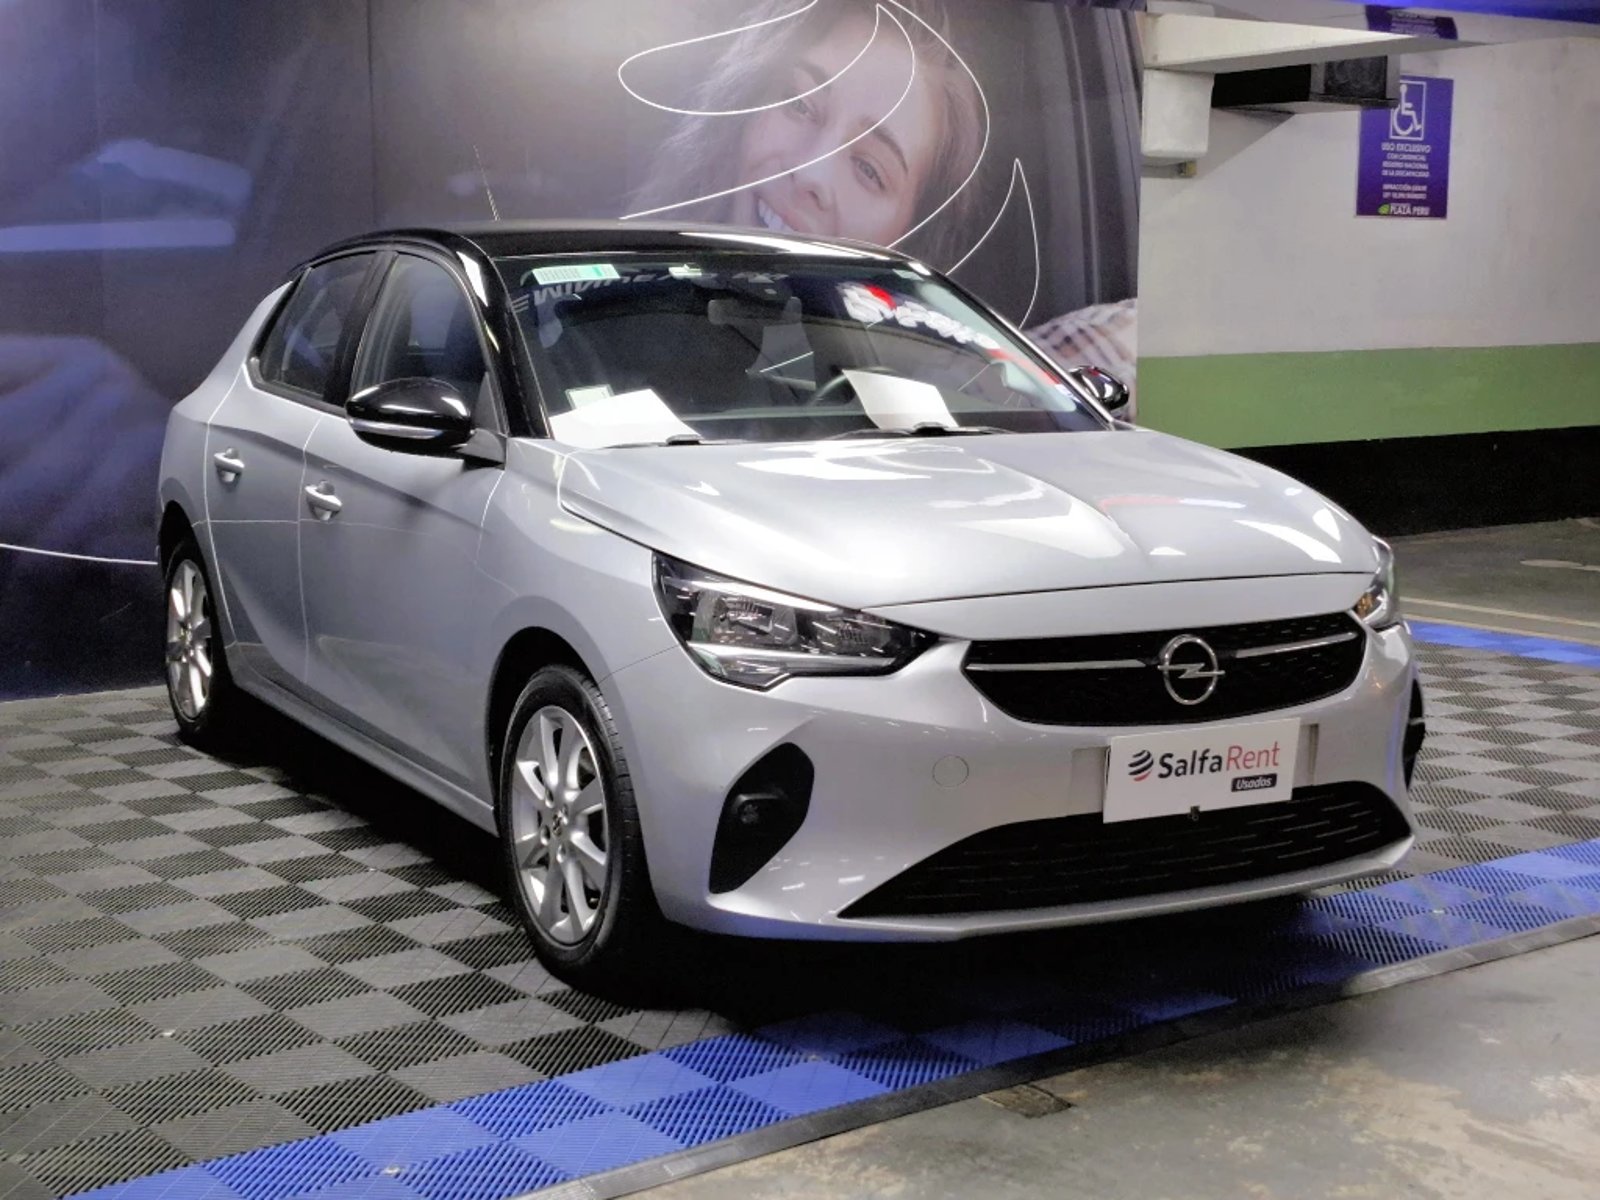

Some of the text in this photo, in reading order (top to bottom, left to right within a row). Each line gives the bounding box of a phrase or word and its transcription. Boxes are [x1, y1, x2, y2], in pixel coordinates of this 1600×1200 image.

[1396, 143, 1431, 153] EXCLUSIVO
[1390, 205, 1411, 215] PLAZA
[1236, 776, 1272, 790] Usados
